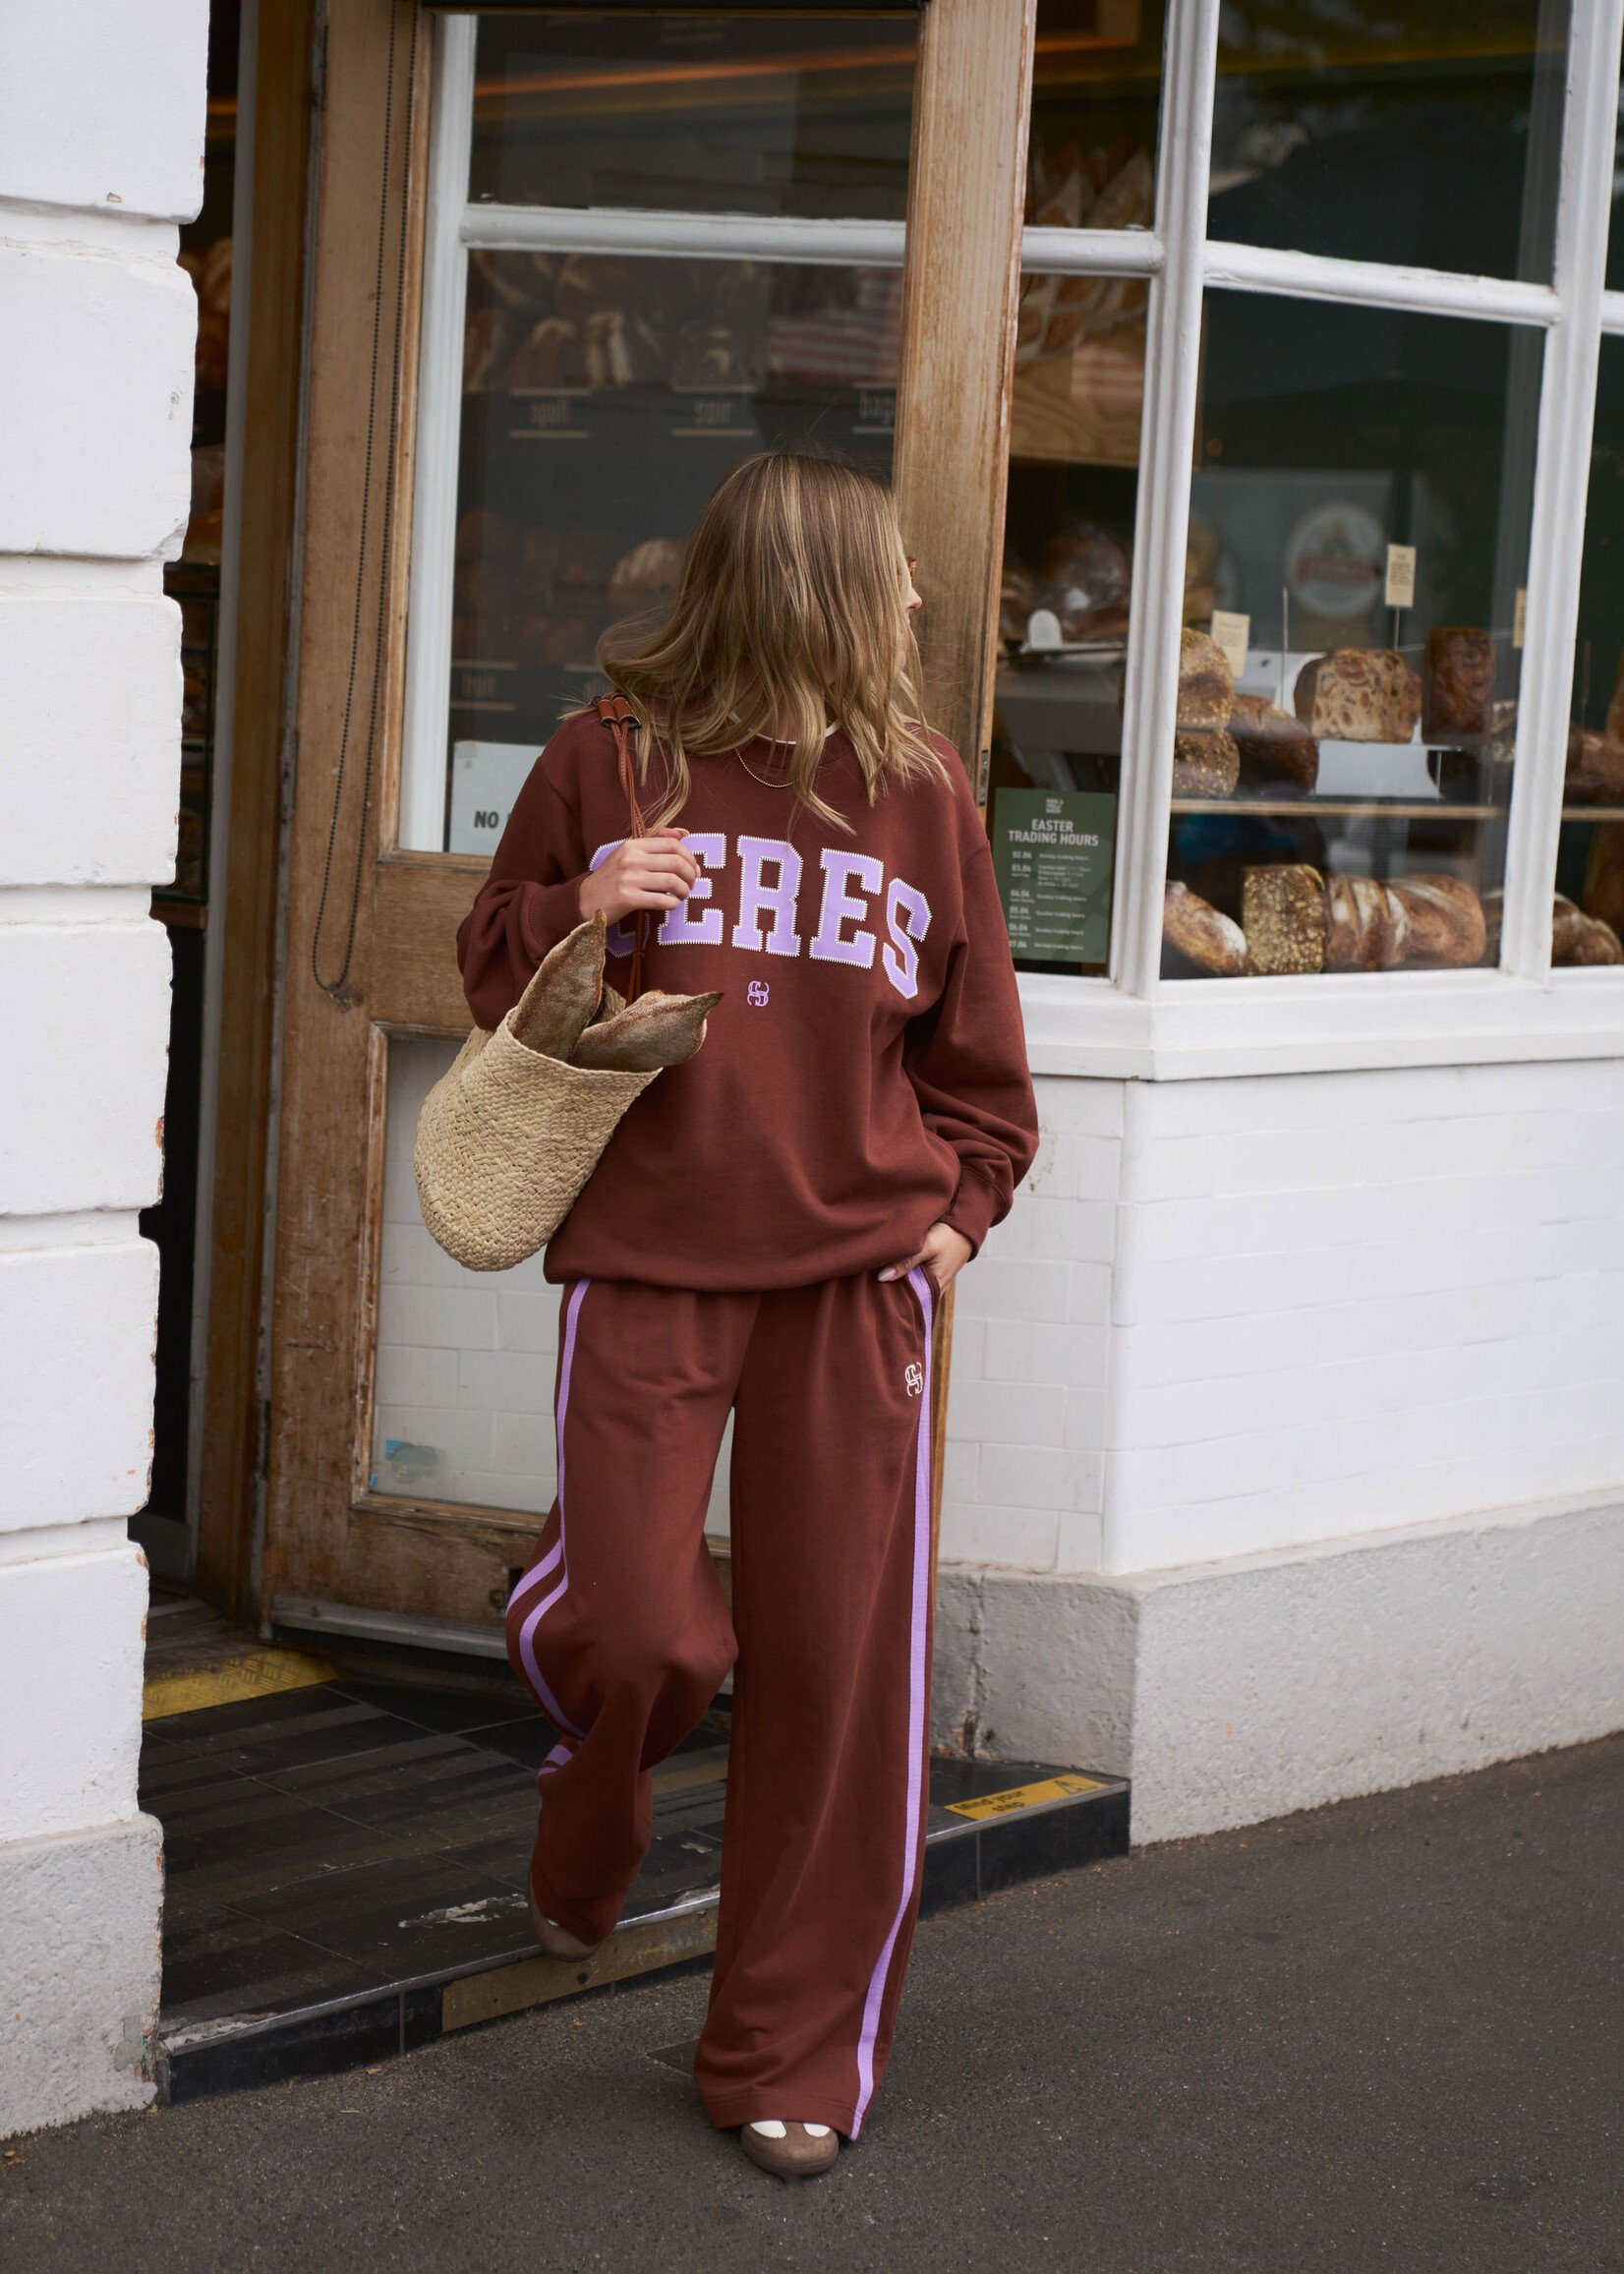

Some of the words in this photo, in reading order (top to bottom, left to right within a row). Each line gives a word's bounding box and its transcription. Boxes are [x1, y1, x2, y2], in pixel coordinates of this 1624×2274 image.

[474, 810, 499, 829] NO
[1031, 818, 1074, 833] EASTER
[1008, 830, 1057, 845] TRADING
[1060, 833, 1100, 847] HOURS
[954, 1798, 993, 1811] Mind
[996, 1790, 1026, 1803] your
[992, 1801, 1025, 1812] step
